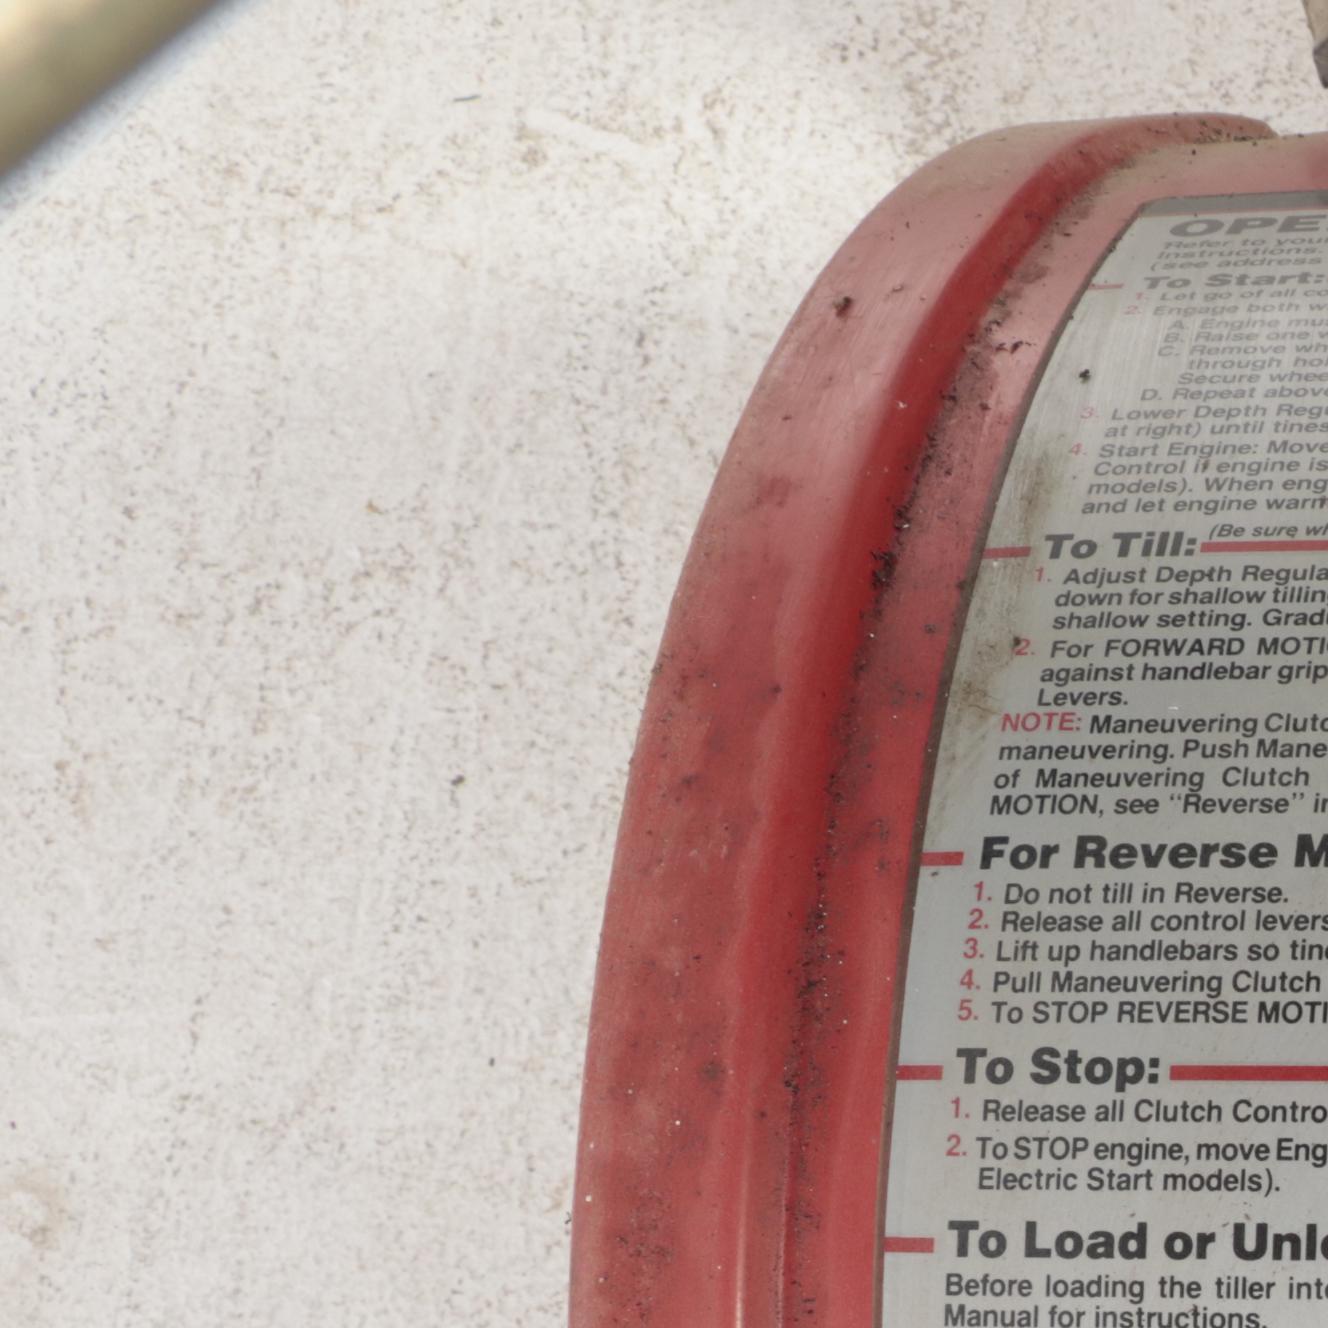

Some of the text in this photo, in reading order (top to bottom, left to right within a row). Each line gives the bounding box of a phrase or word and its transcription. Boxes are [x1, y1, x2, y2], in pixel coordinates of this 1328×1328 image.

[1144, 272, 1325, 289] To Start:
[1045, 532, 1196, 559] To Till:
[1052, 612, 1149, 630] shallow
[1157, 610, 1251, 631] setting.
[980, 836, 1059, 870] For
[1074, 836, 1278, 869] Reverse
[956, 1047, 1160, 1092] To Stop:
[978, 1166, 1280, 1197] Electric Start models).
[948, 1220, 1006, 1258] To
[1025, 1221, 1147, 1260] Load
[1164, 1232, 1216, 1260] or
